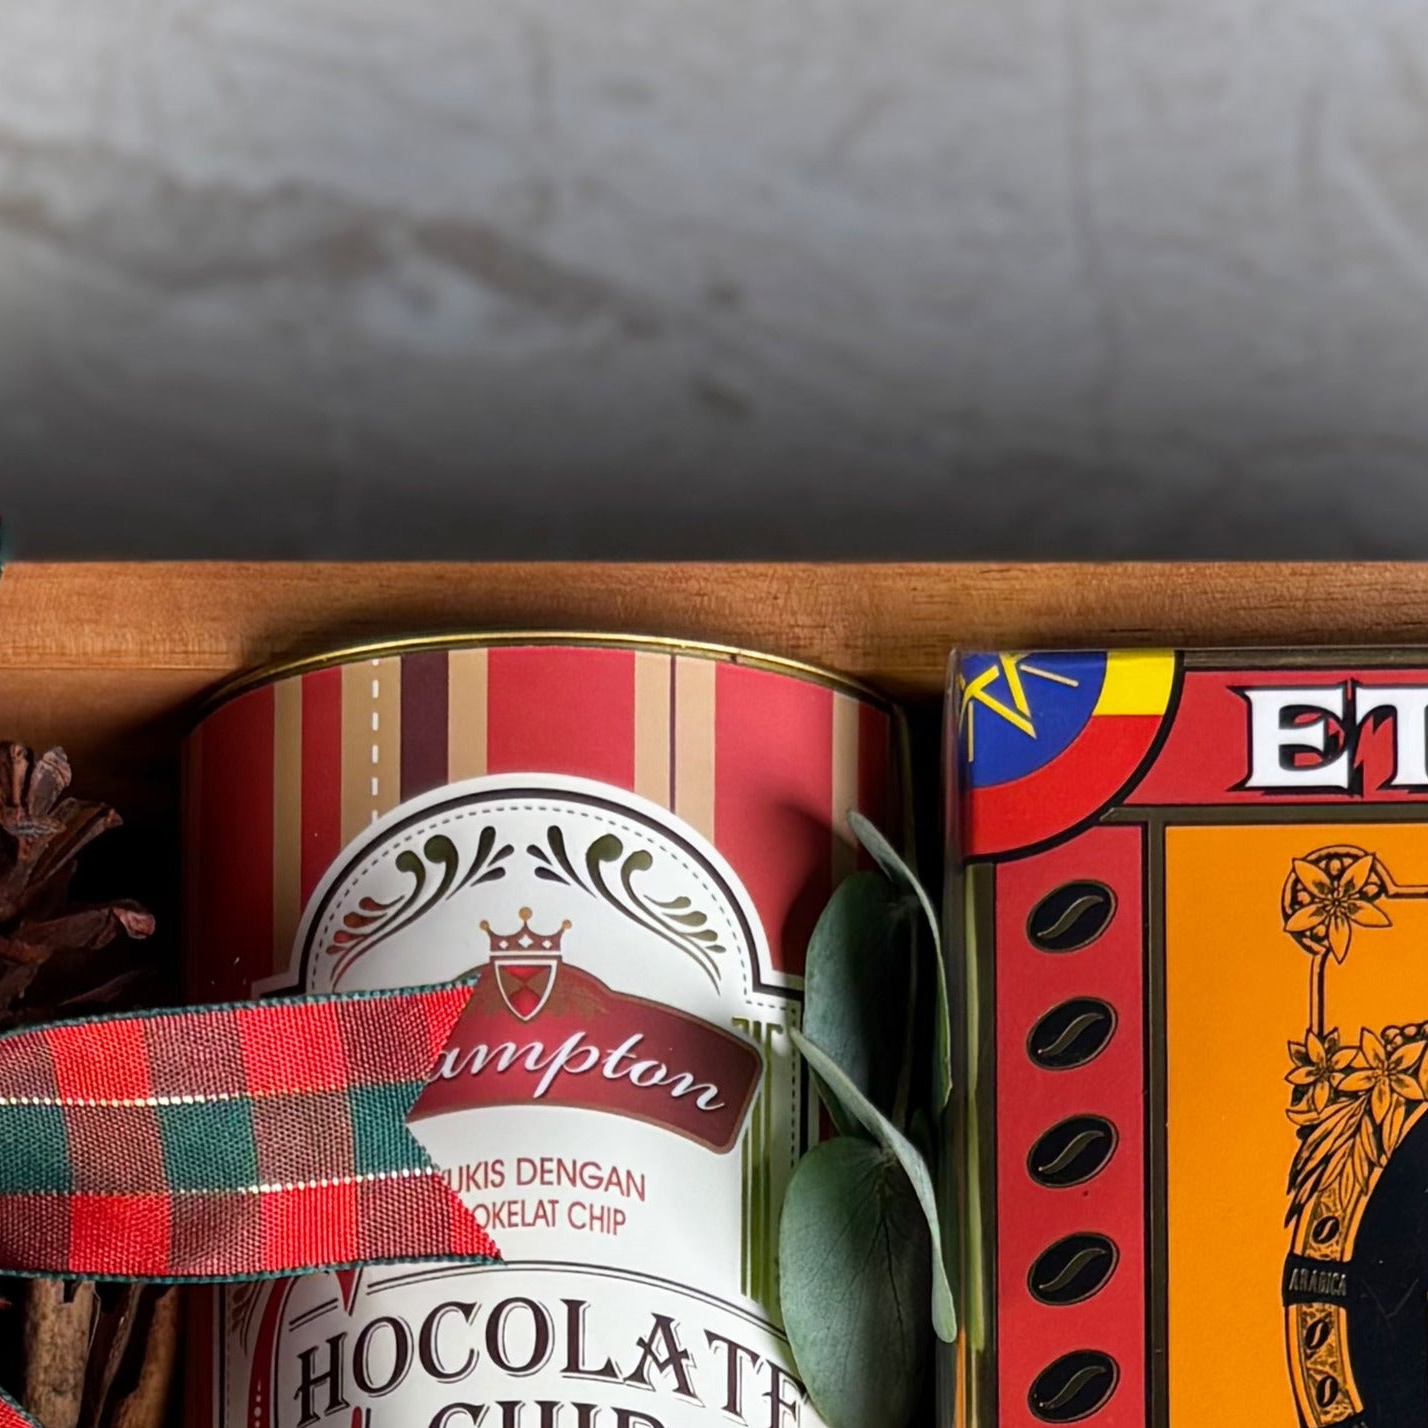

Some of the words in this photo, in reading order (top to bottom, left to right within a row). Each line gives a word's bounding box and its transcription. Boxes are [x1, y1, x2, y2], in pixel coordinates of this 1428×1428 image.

[427, 1031, 725, 1111] ampton
[516, 1157, 645, 1203] DENGAN
[475, 1199, 559, 1230] OKELAT
[568, 1202, 627, 1236] CHIP
